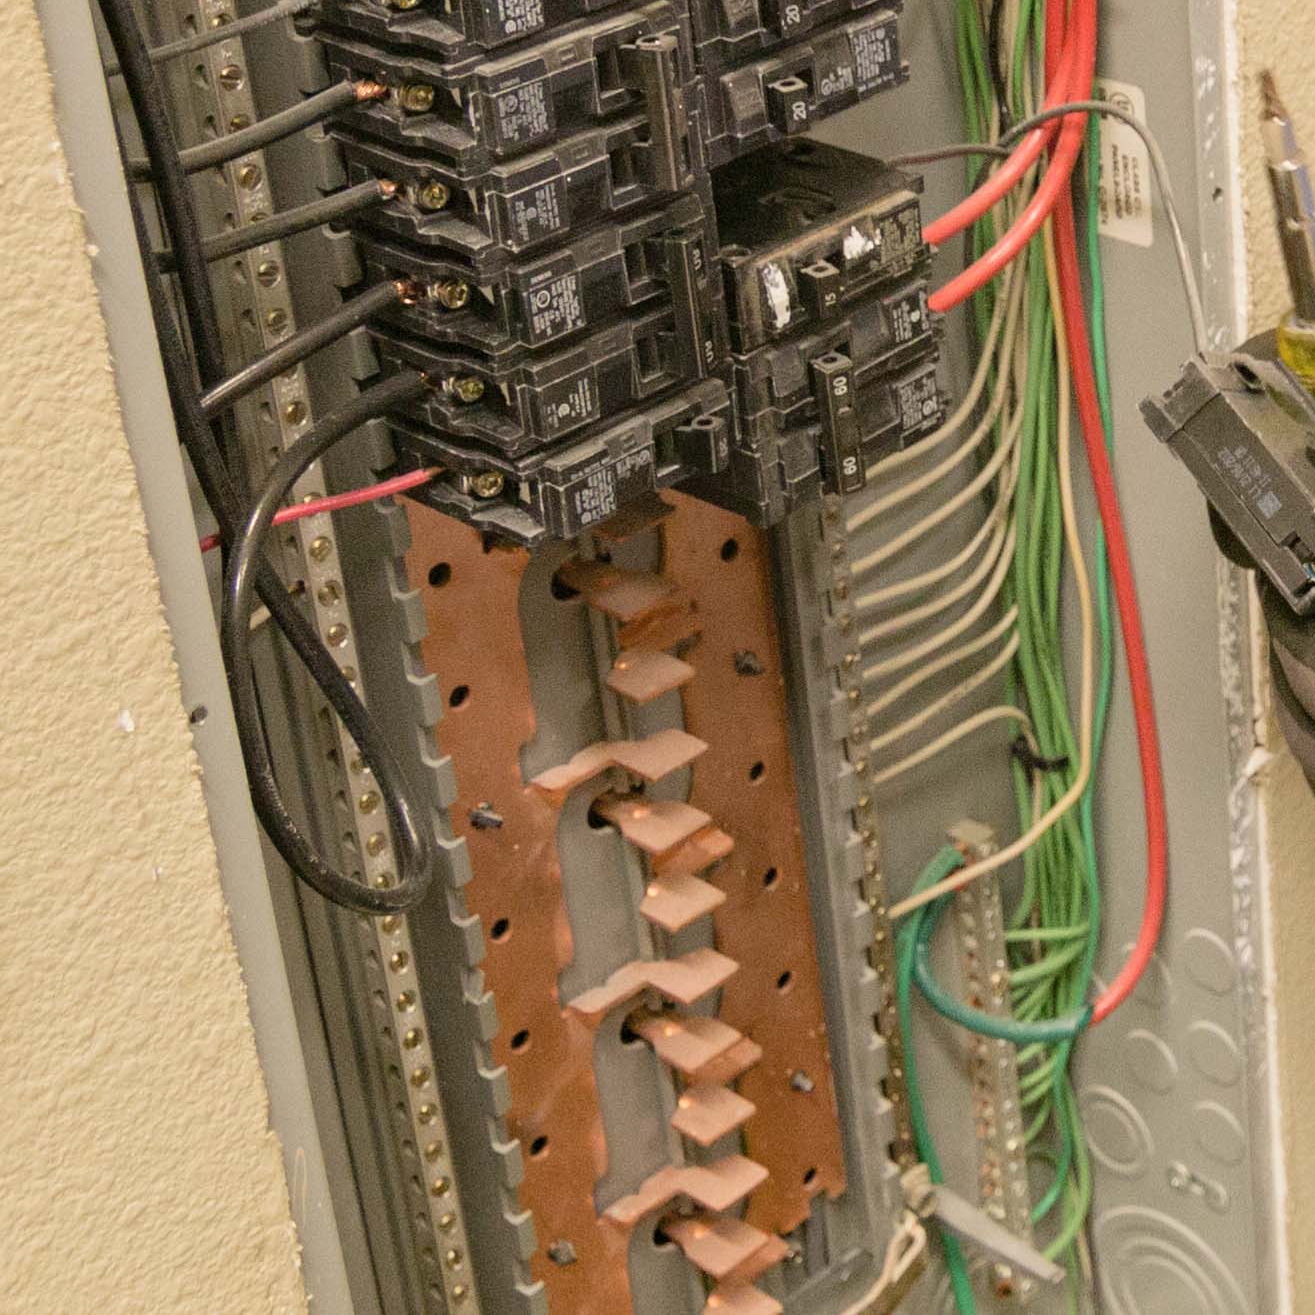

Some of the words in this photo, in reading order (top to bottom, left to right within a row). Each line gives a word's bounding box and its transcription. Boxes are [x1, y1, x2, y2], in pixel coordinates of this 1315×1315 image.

[786, 4, 800, 24] 20
[793, 101, 807, 121] 20
[824, 292, 836, 306] 15
[832, 375, 846, 396] 60
[843, 455, 856, 476] 60
